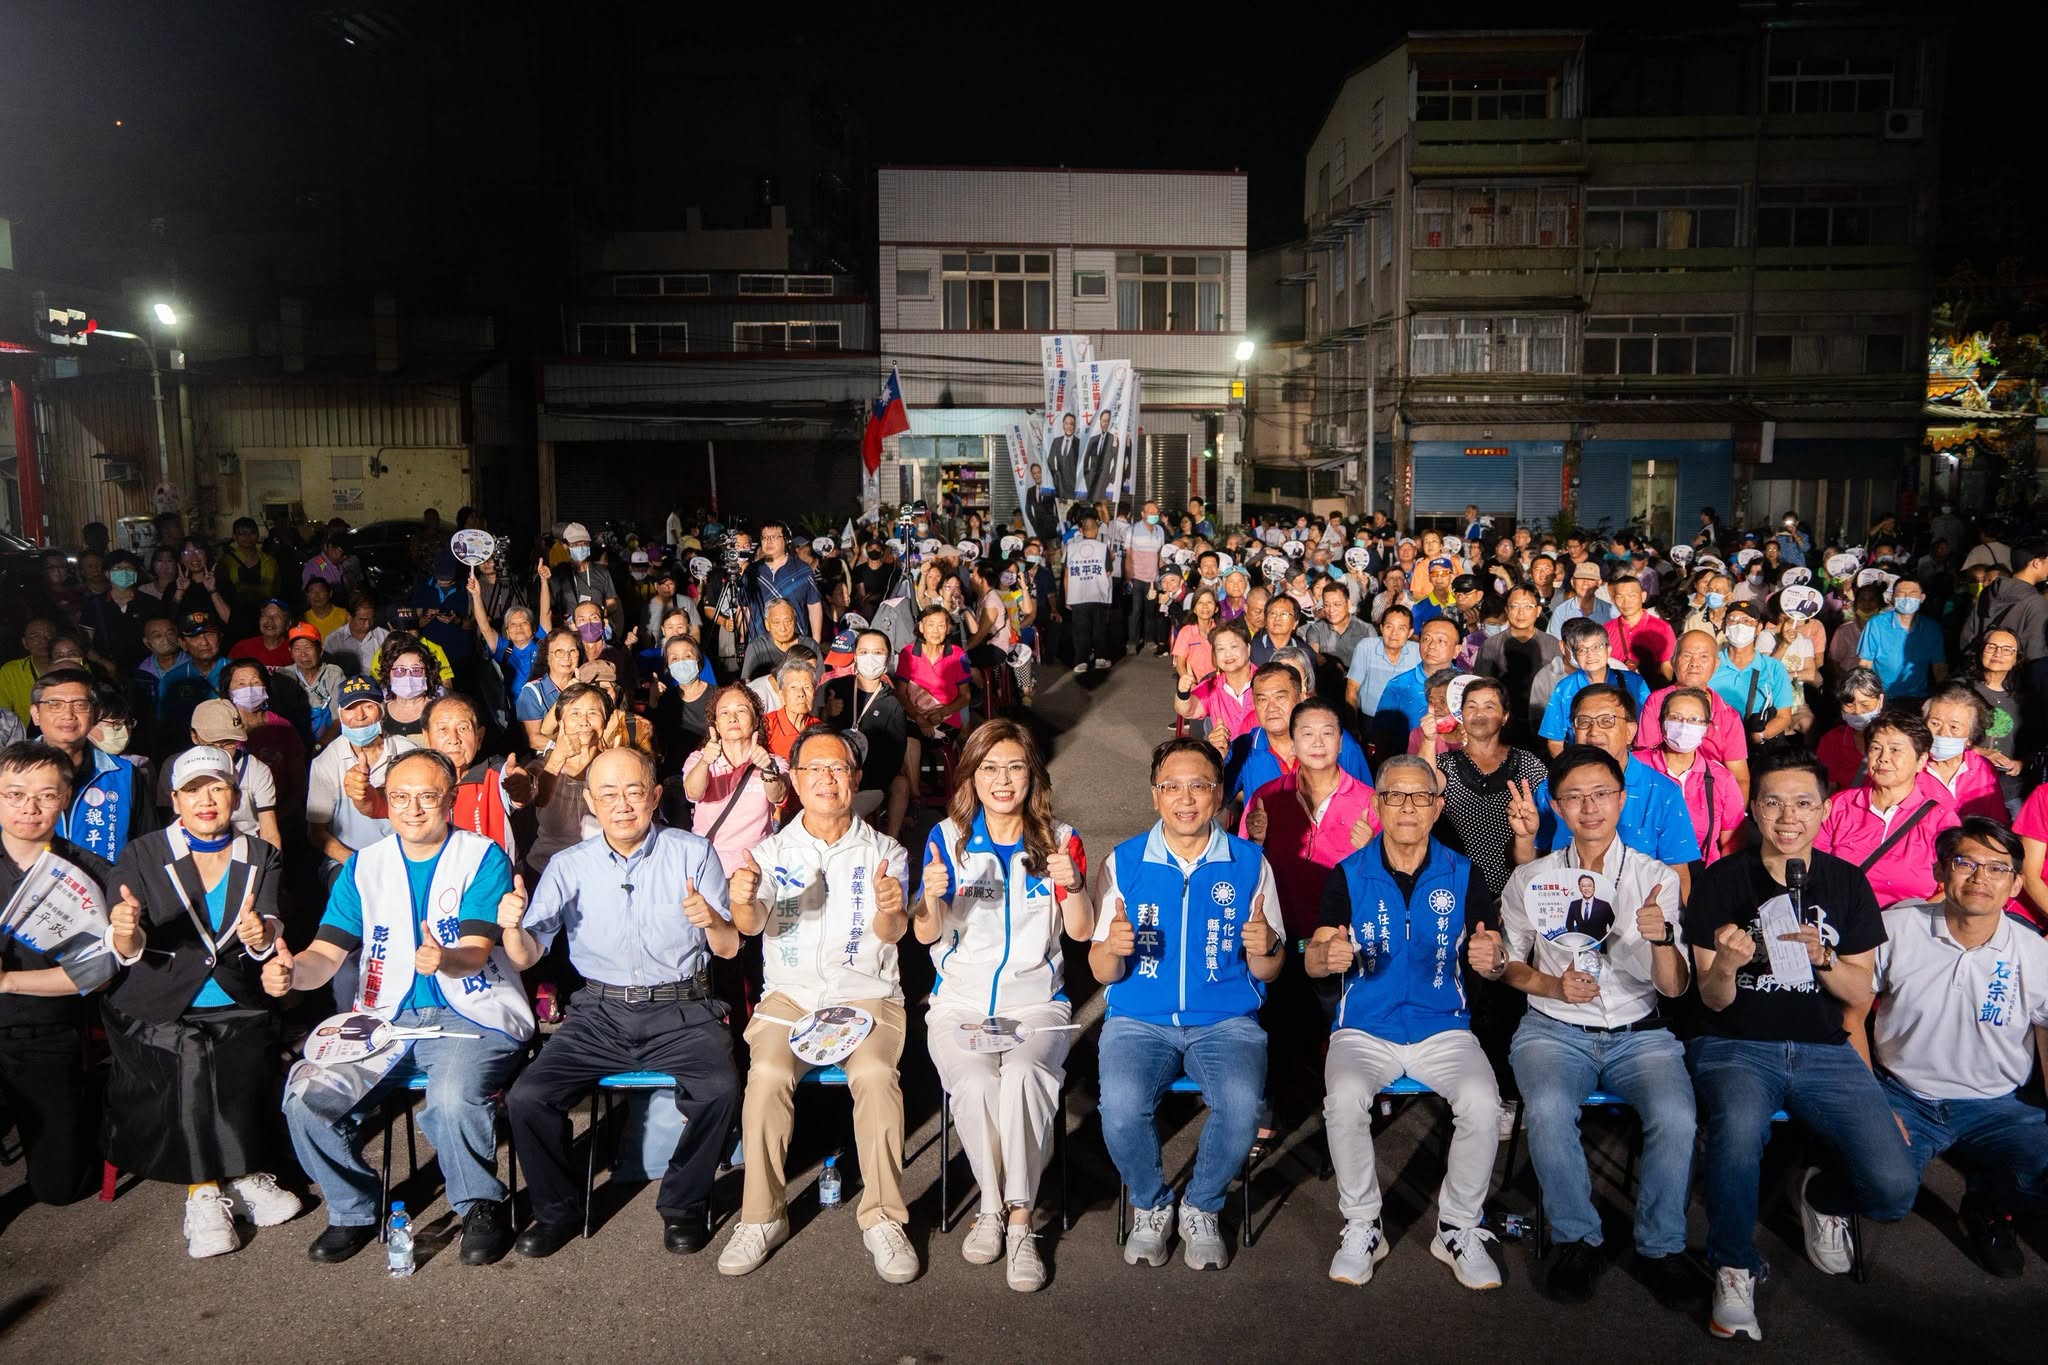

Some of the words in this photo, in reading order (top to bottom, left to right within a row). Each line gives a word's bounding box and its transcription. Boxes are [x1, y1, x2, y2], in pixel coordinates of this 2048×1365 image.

[1070, 565, 1102, 576] 魏平政
[85, 808, 105, 853] 魏平
[1138, 903, 1159, 979] 魏平政
[1205, 918, 1220, 982] 縣長候選人
[1221, 907, 1236, 952] 彰化縣
[1378, 900, 1391, 953] 主任委員
[364, 925, 389, 1008] 彰化正能量
[1979, 961, 2011, 1026] 石宗凱
